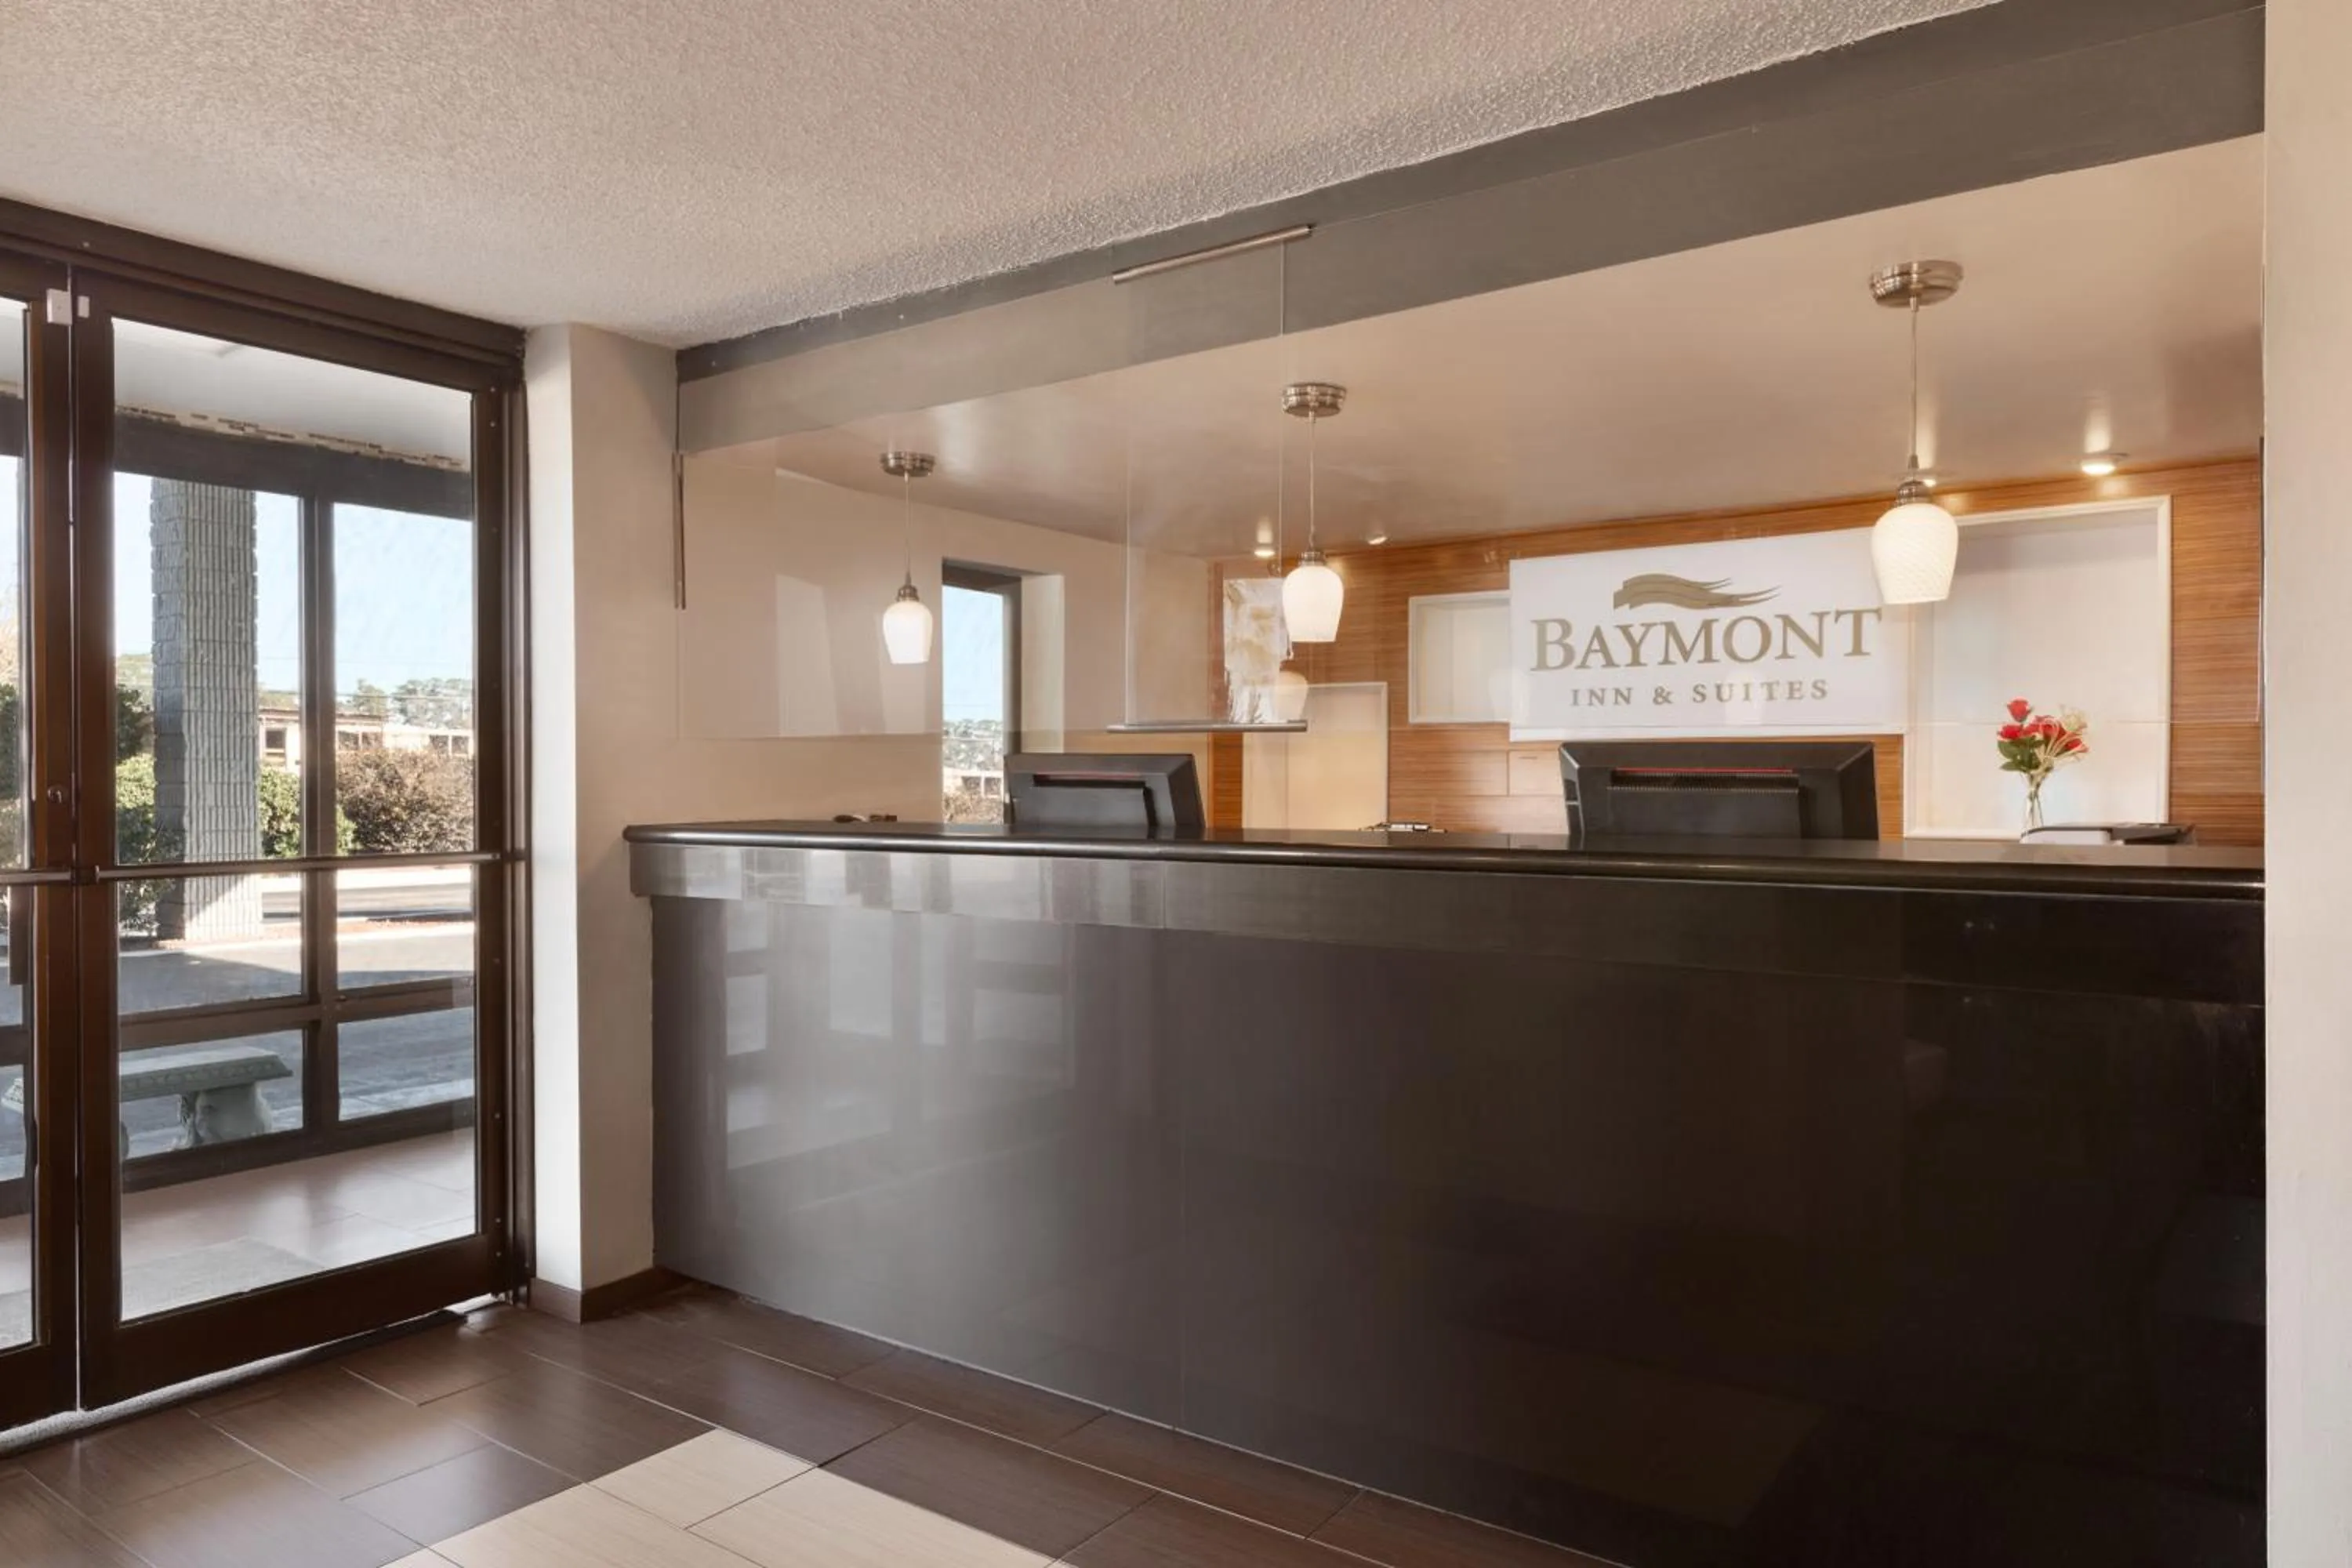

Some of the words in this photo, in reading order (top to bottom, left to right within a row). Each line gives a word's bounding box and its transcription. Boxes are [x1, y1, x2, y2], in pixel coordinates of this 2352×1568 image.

[1530, 608, 1882, 672] BAYMONT
[1572, 687, 1633, 706] INN
[1652, 685, 1673, 705] &
[1692, 679, 1828, 702] SUITES
